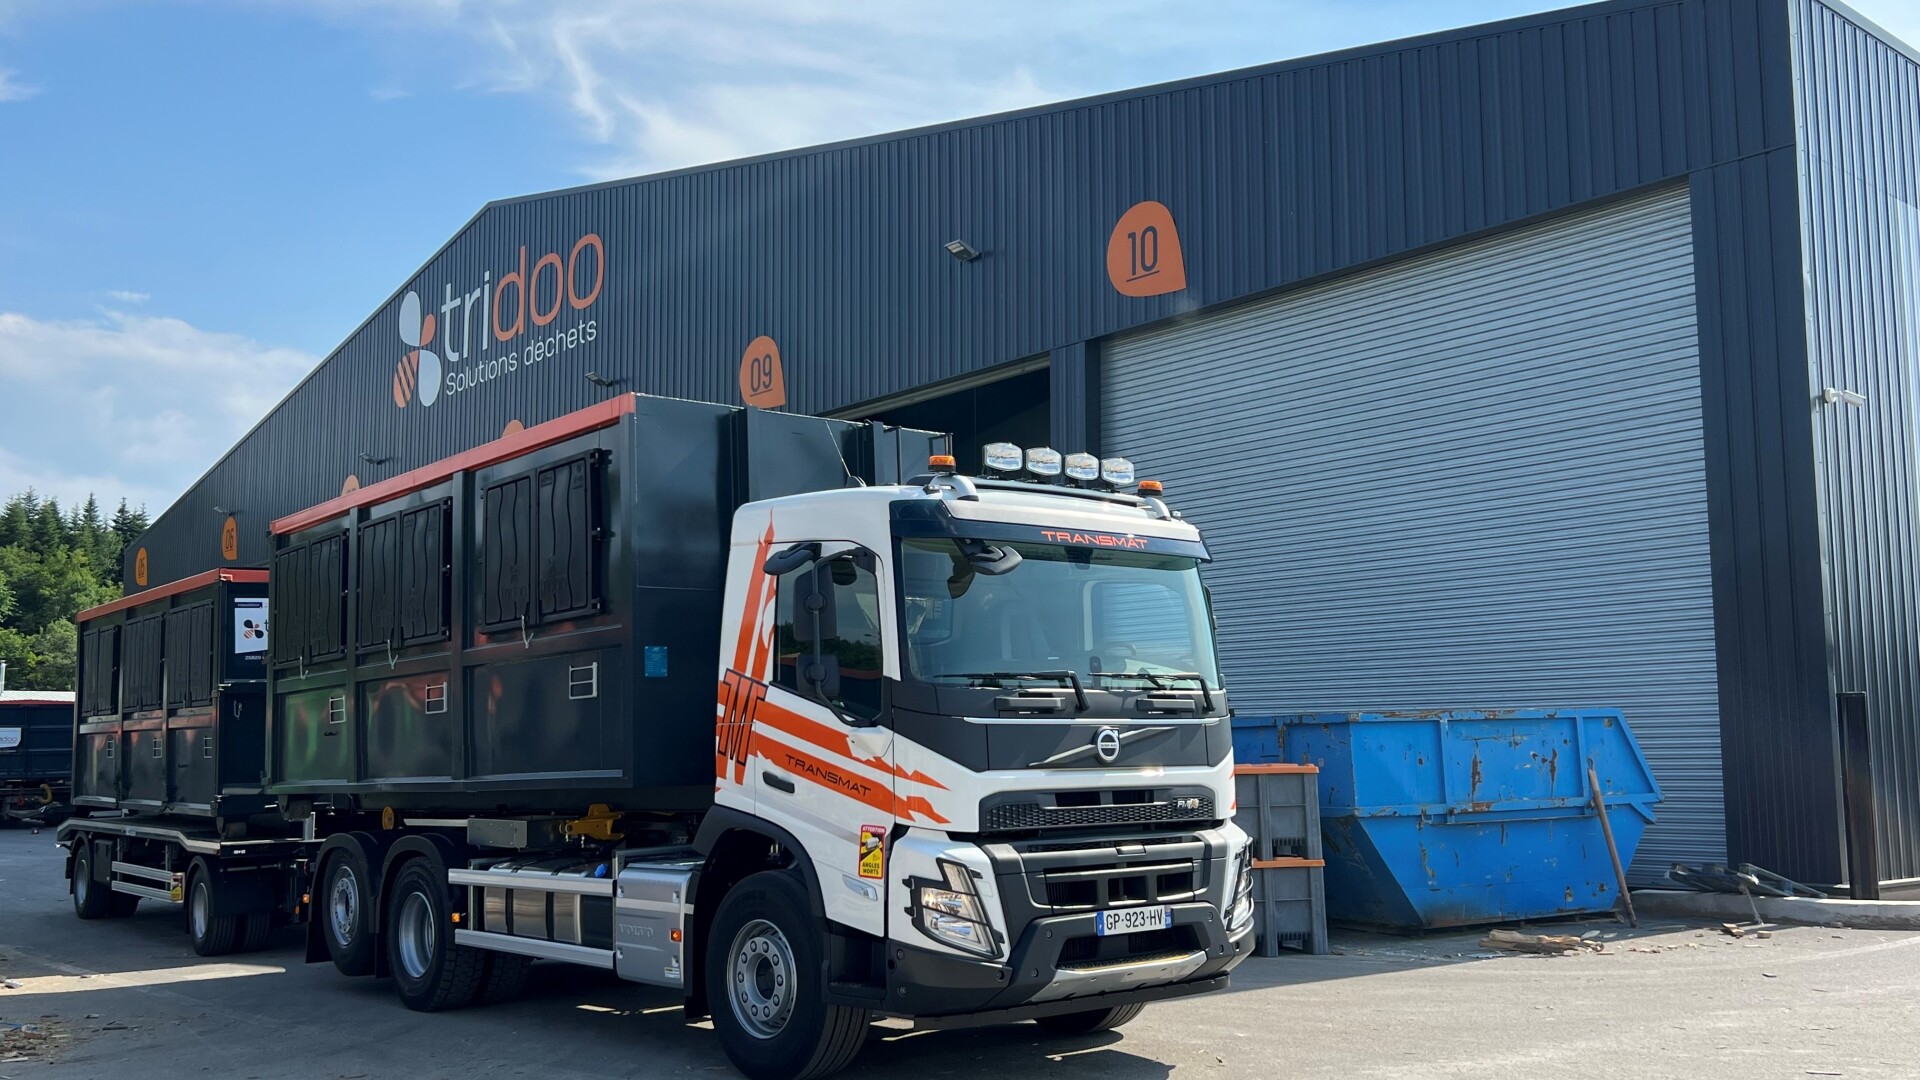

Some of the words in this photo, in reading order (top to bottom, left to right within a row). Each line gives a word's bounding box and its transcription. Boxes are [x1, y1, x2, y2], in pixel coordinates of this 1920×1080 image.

[1127, 225, 1158, 276] 10
[440, 233, 604, 362] tridoo
[446, 351, 518, 396] Solutions
[524, 319, 597, 366] déchets
[751, 353, 772, 393] 09
[225, 528, 234, 549] 06
[1040, 531, 1148, 549] TRANSMAT
[785, 753, 871, 796] TRANSMAT
[1106, 908, 1163, 931] GP-923-HV
